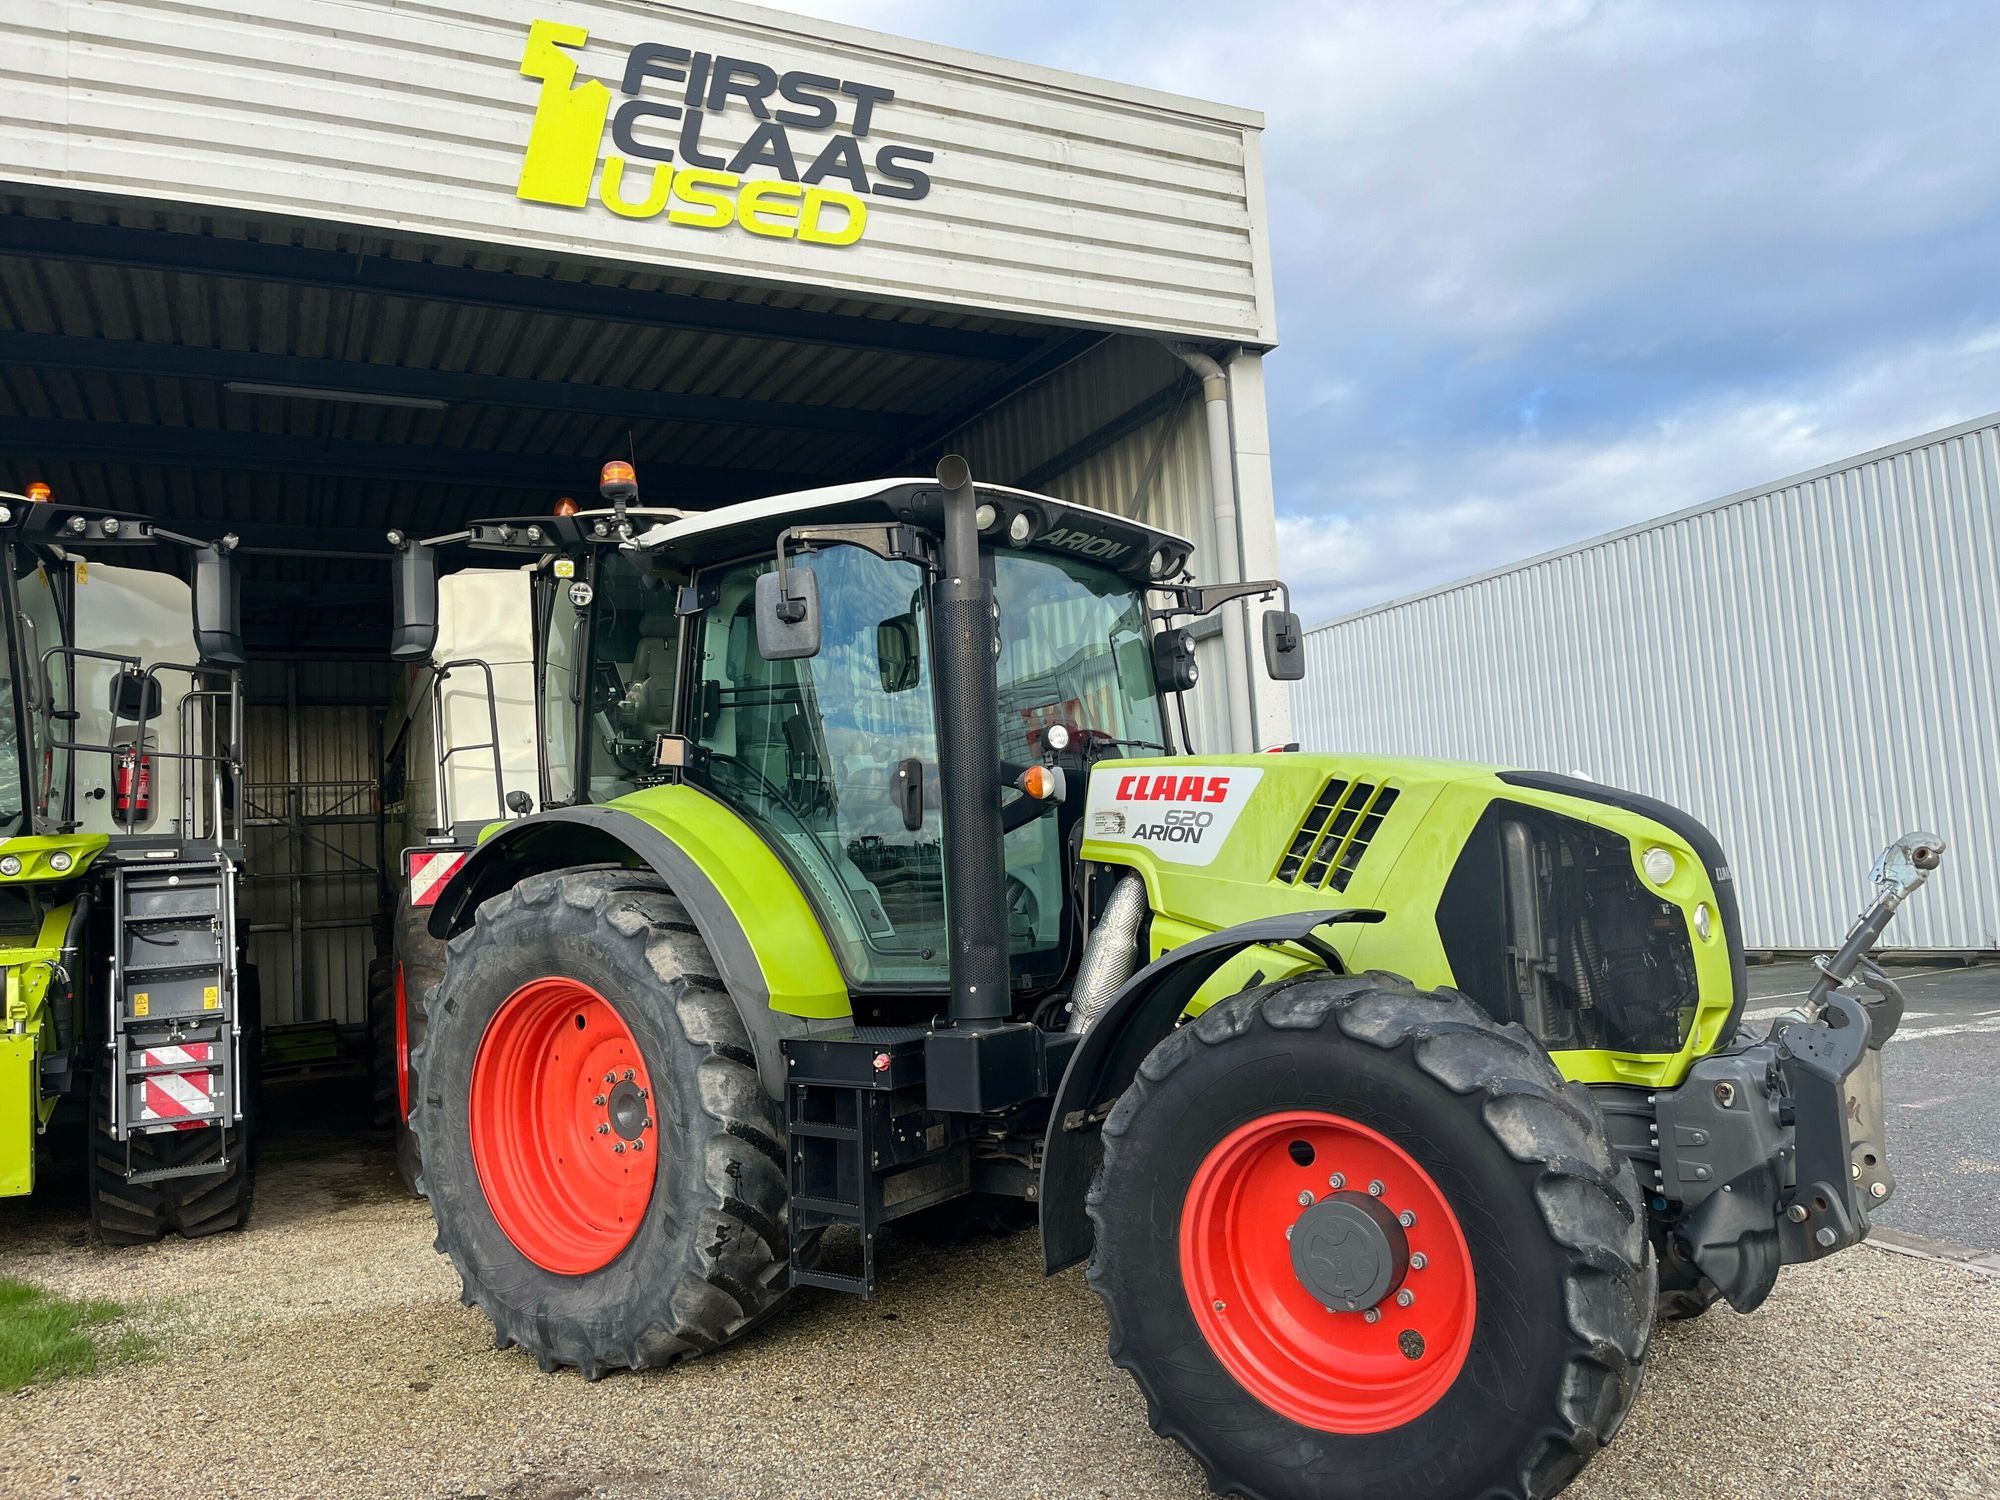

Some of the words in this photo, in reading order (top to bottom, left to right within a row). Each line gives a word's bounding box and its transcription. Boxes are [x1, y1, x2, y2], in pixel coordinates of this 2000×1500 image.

[620, 42, 895, 137] FIRST
[612, 100, 934, 200] CLAAS
[600, 156, 868, 246] USED
[1035, 528, 1130, 559] ARION
[1115, 775, 1231, 804] CLAAS
[1132, 823, 1204, 844] ARION
[1164, 809, 1214, 828] 620
